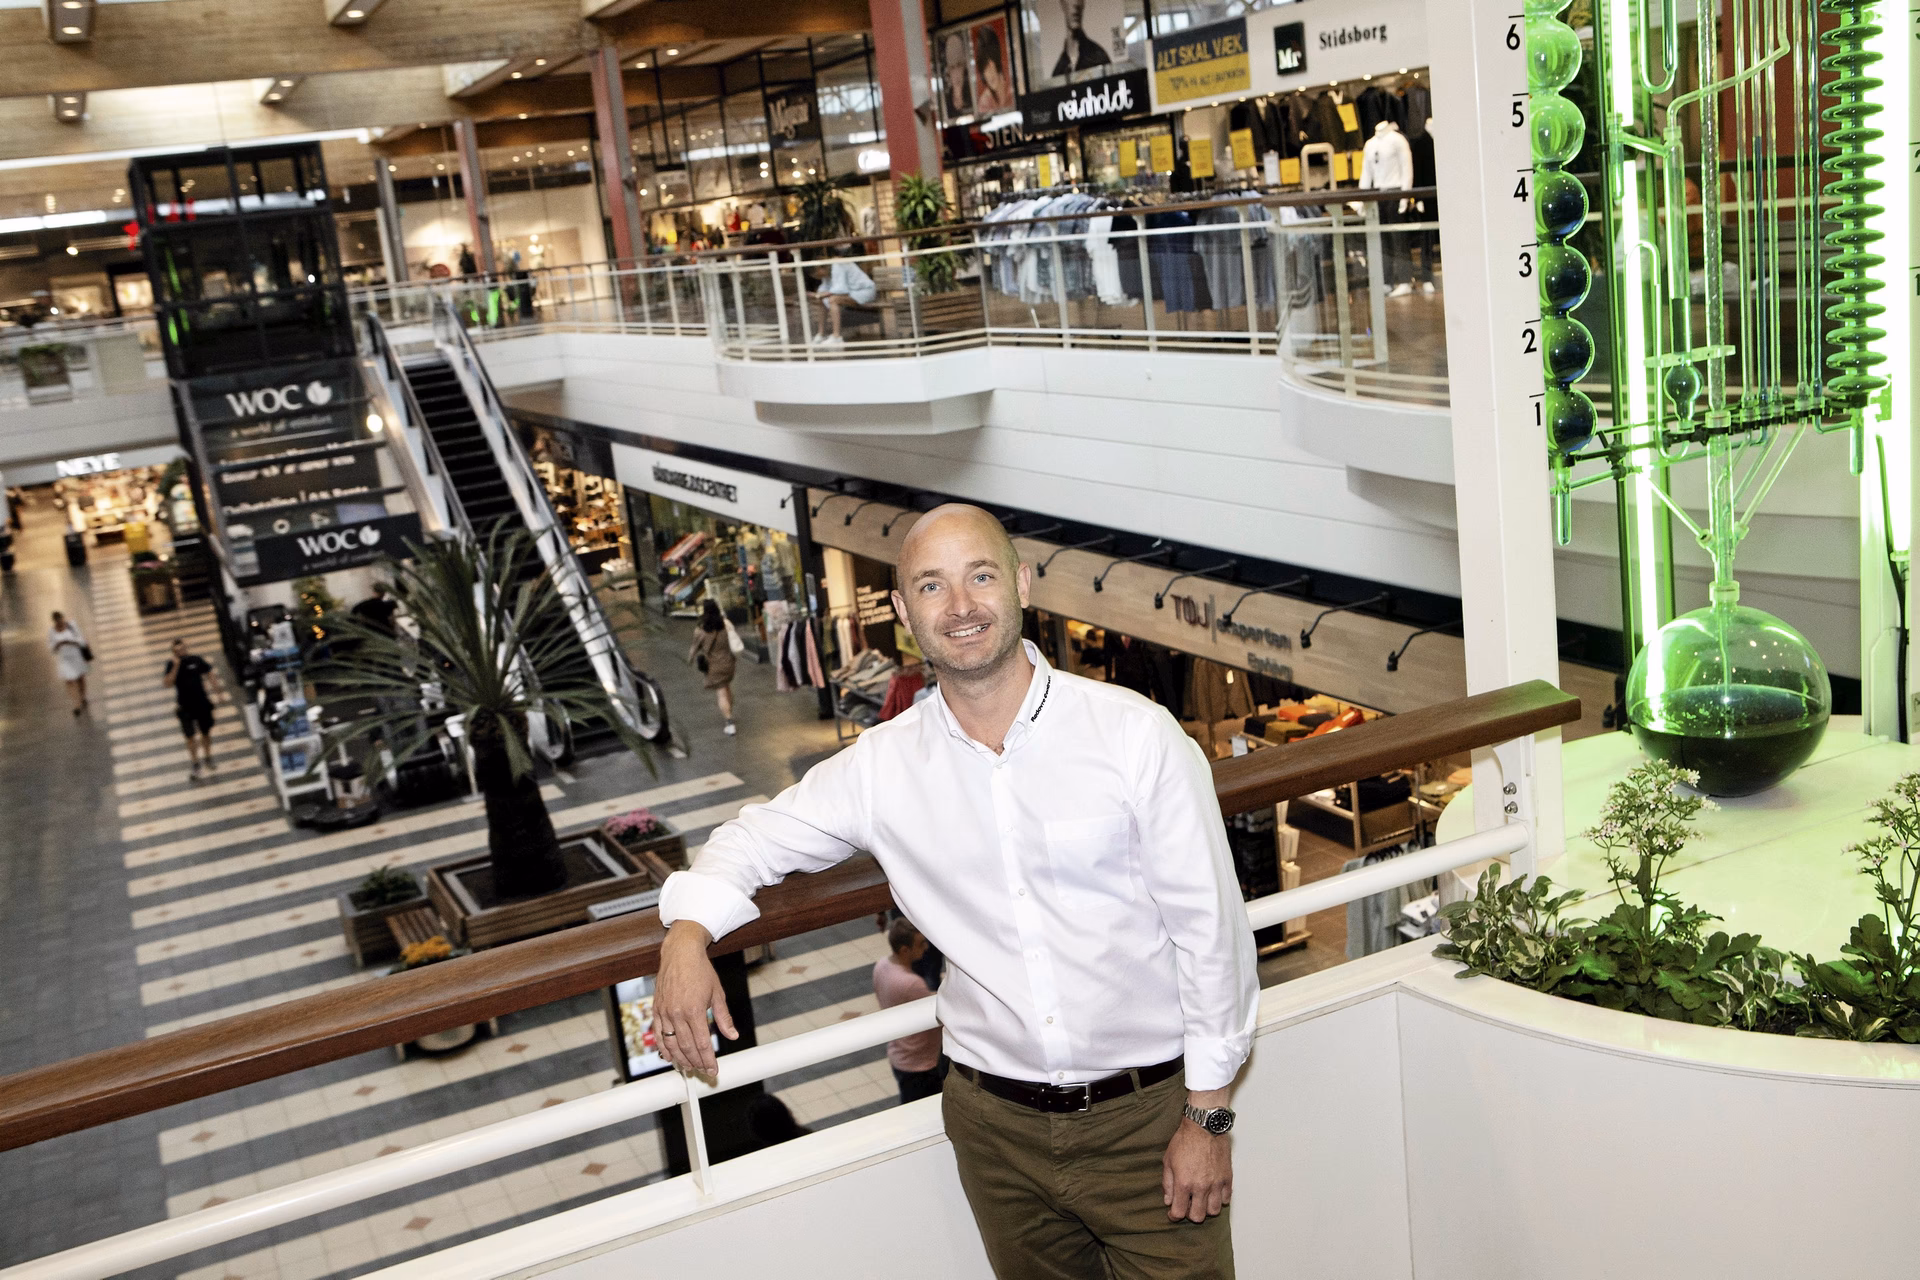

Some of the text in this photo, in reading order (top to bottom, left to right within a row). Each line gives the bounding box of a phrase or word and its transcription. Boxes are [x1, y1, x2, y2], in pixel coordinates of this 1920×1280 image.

[1319, 23, 1388, 51] Stidsborg
[1506, 23, 1521, 51] 6
[1156, 33, 1243, 71] ALT SKAL VÆK
[1278, 47, 1302, 70] Mr
[1057, 79, 1134, 122] reinholdt
[1512, 101, 1524, 128] 5
[1513, 176, 1529, 203] 4
[1518, 251, 1533, 278] 3
[1521, 328, 1538, 355] 2
[225, 384, 303, 418] WOC
[1534, 401, 1542, 427] 1
[296, 528, 359, 557] WOC
[1170, 594, 1209, 629] TØJ
